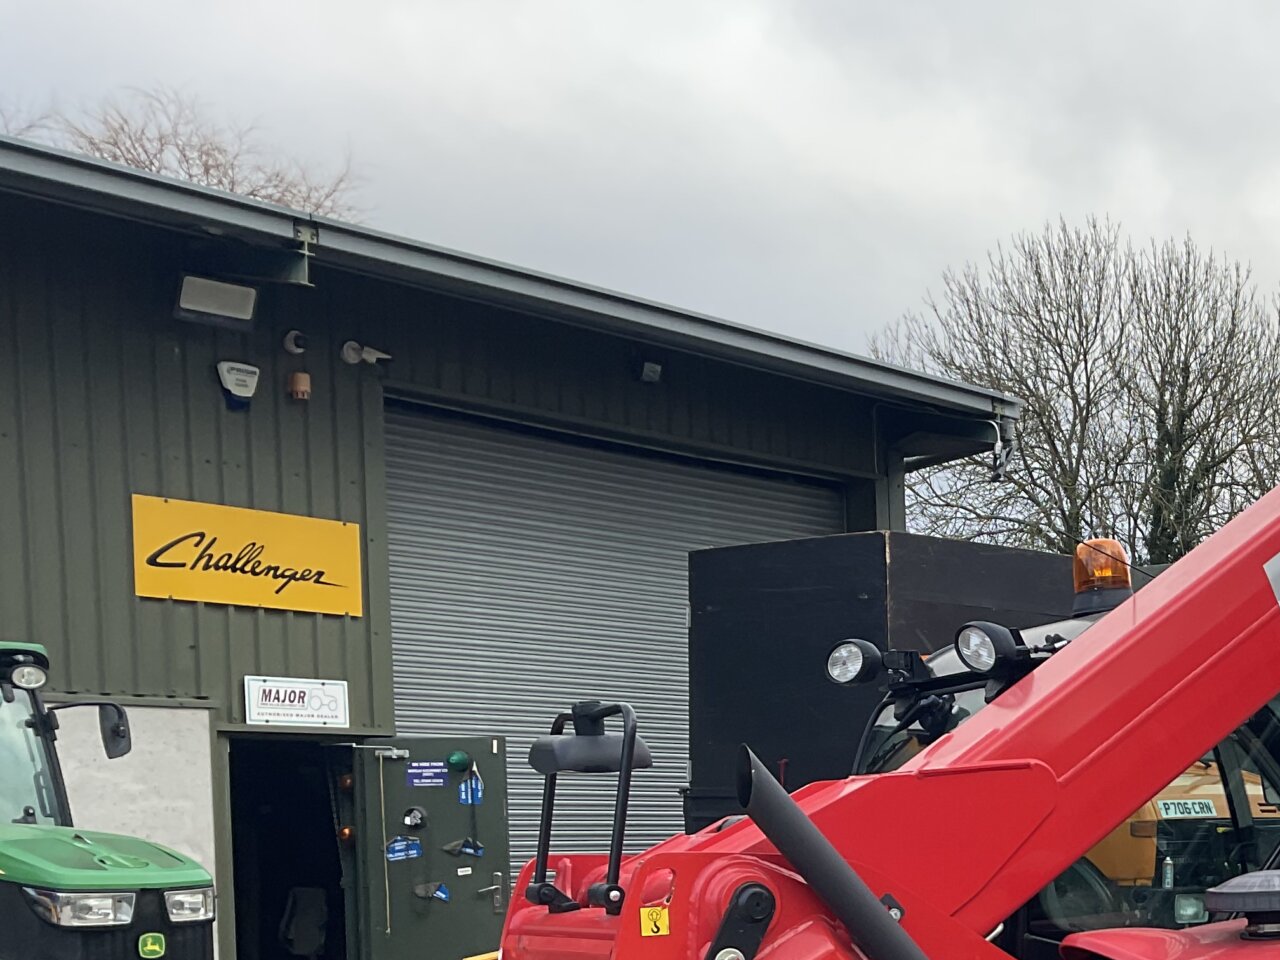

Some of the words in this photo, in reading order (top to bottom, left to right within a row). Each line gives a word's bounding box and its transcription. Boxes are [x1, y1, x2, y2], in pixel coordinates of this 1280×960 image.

[146, 531, 348, 594] Challenger
[261, 688, 307, 704] MAJOR
[1163, 802, 1191, 815] P706
[1191, 802, 1213, 815] CRN
